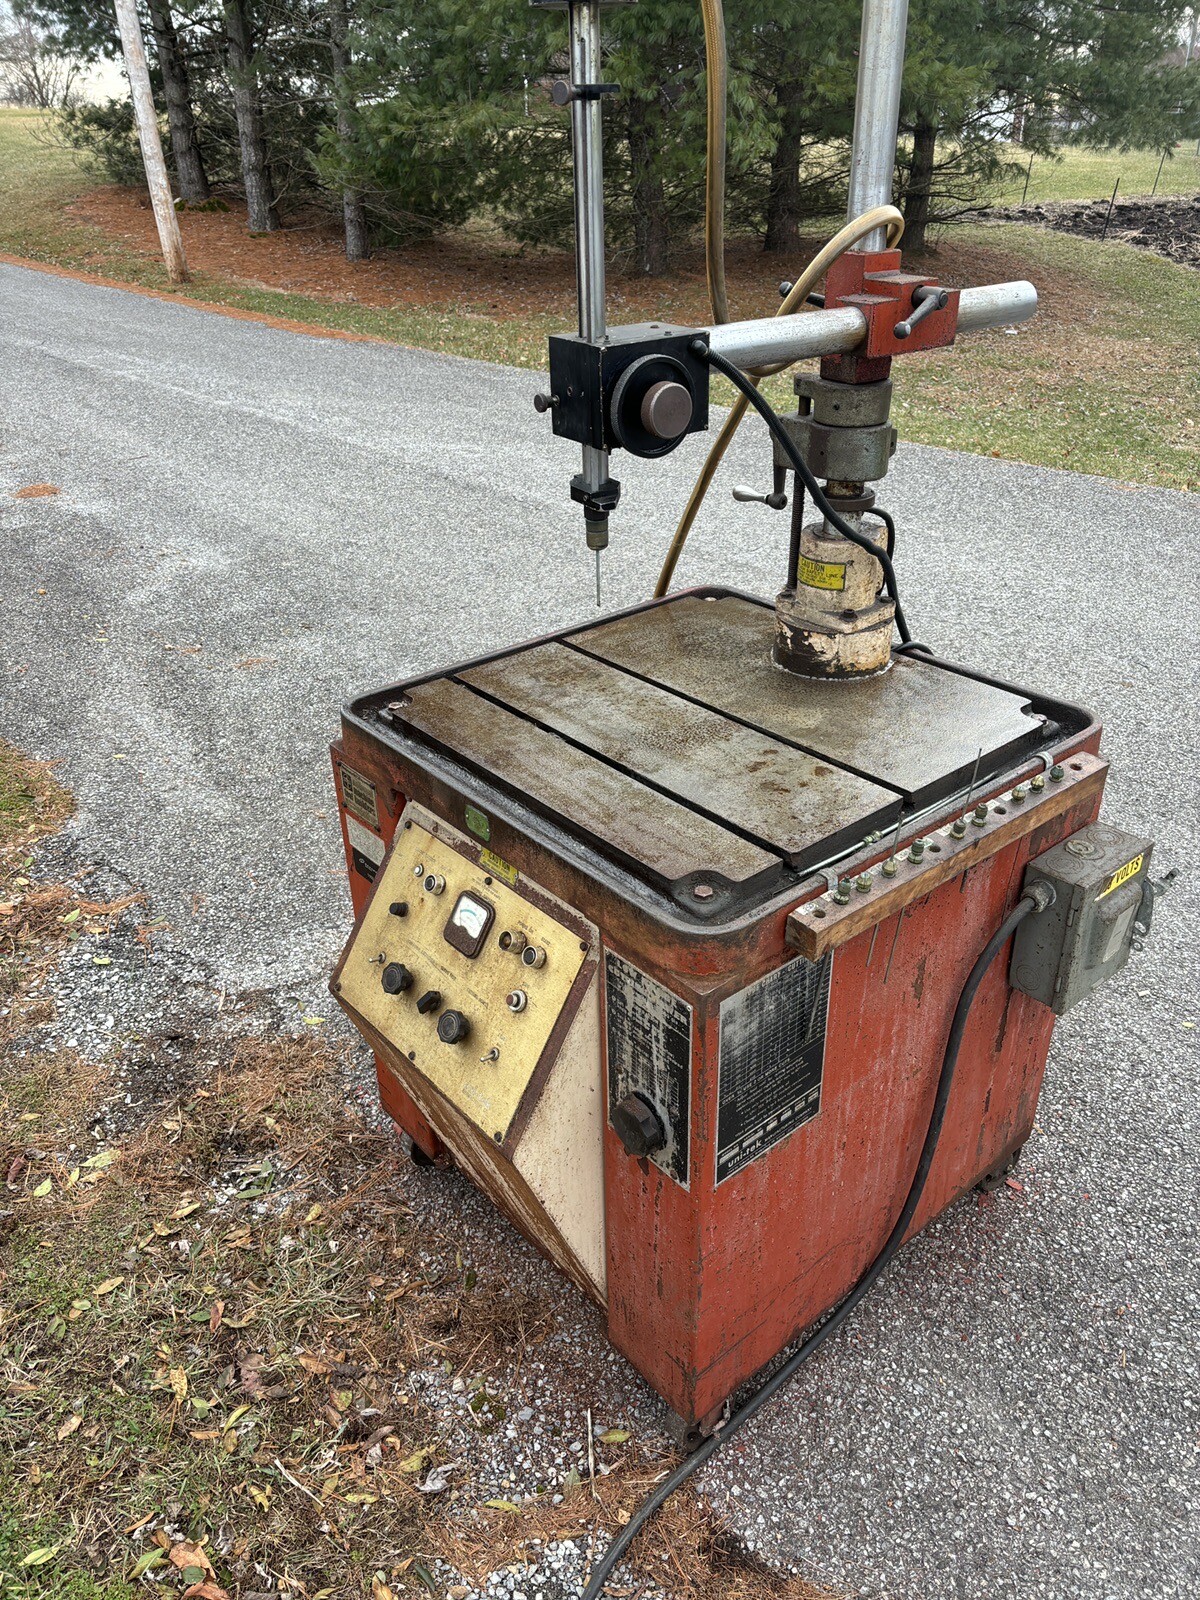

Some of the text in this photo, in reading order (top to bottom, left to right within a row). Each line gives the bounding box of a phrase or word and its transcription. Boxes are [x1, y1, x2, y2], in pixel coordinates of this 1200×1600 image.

[800, 558, 825, 573] CAUTION
[489, 852, 510, 870] CAUTION
[1115, 857, 1140, 884] VOLTS
[728, 1139, 762, 1167] uni-tek
